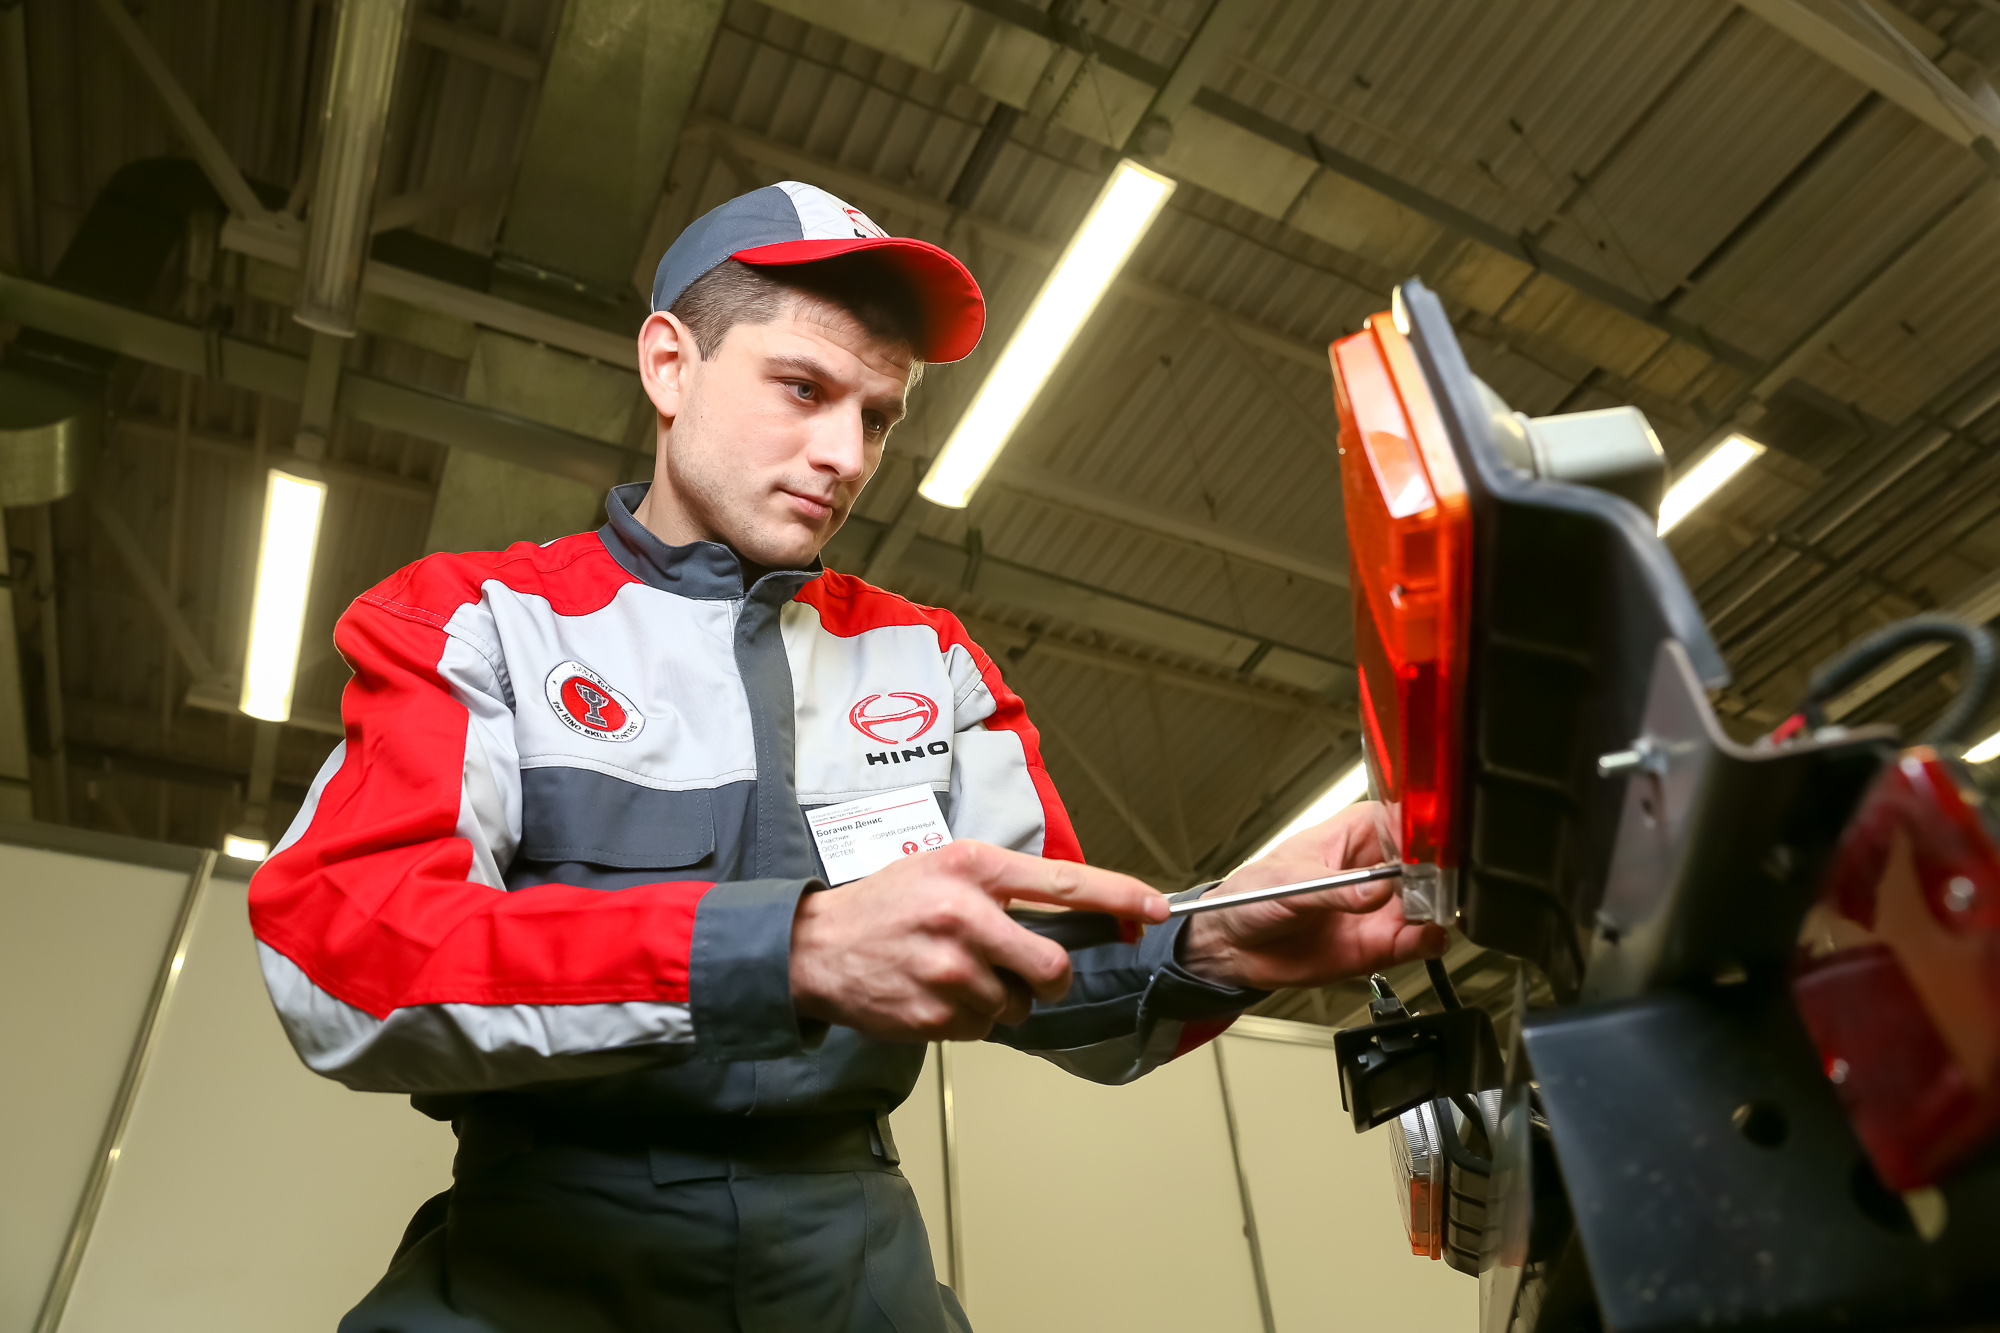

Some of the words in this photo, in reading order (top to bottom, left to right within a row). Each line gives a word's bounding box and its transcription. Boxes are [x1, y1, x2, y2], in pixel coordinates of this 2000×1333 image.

[562, 713, 581, 731] HINO
[866, 741, 949, 766] HINO
[816, 824, 853, 837] Богачев
[855, 817, 883, 829] Денис
[822, 844, 839, 853] ООО
[897, 820, 937, 834] ОХРАННЫХ
[819, 834, 850, 845] Участник
